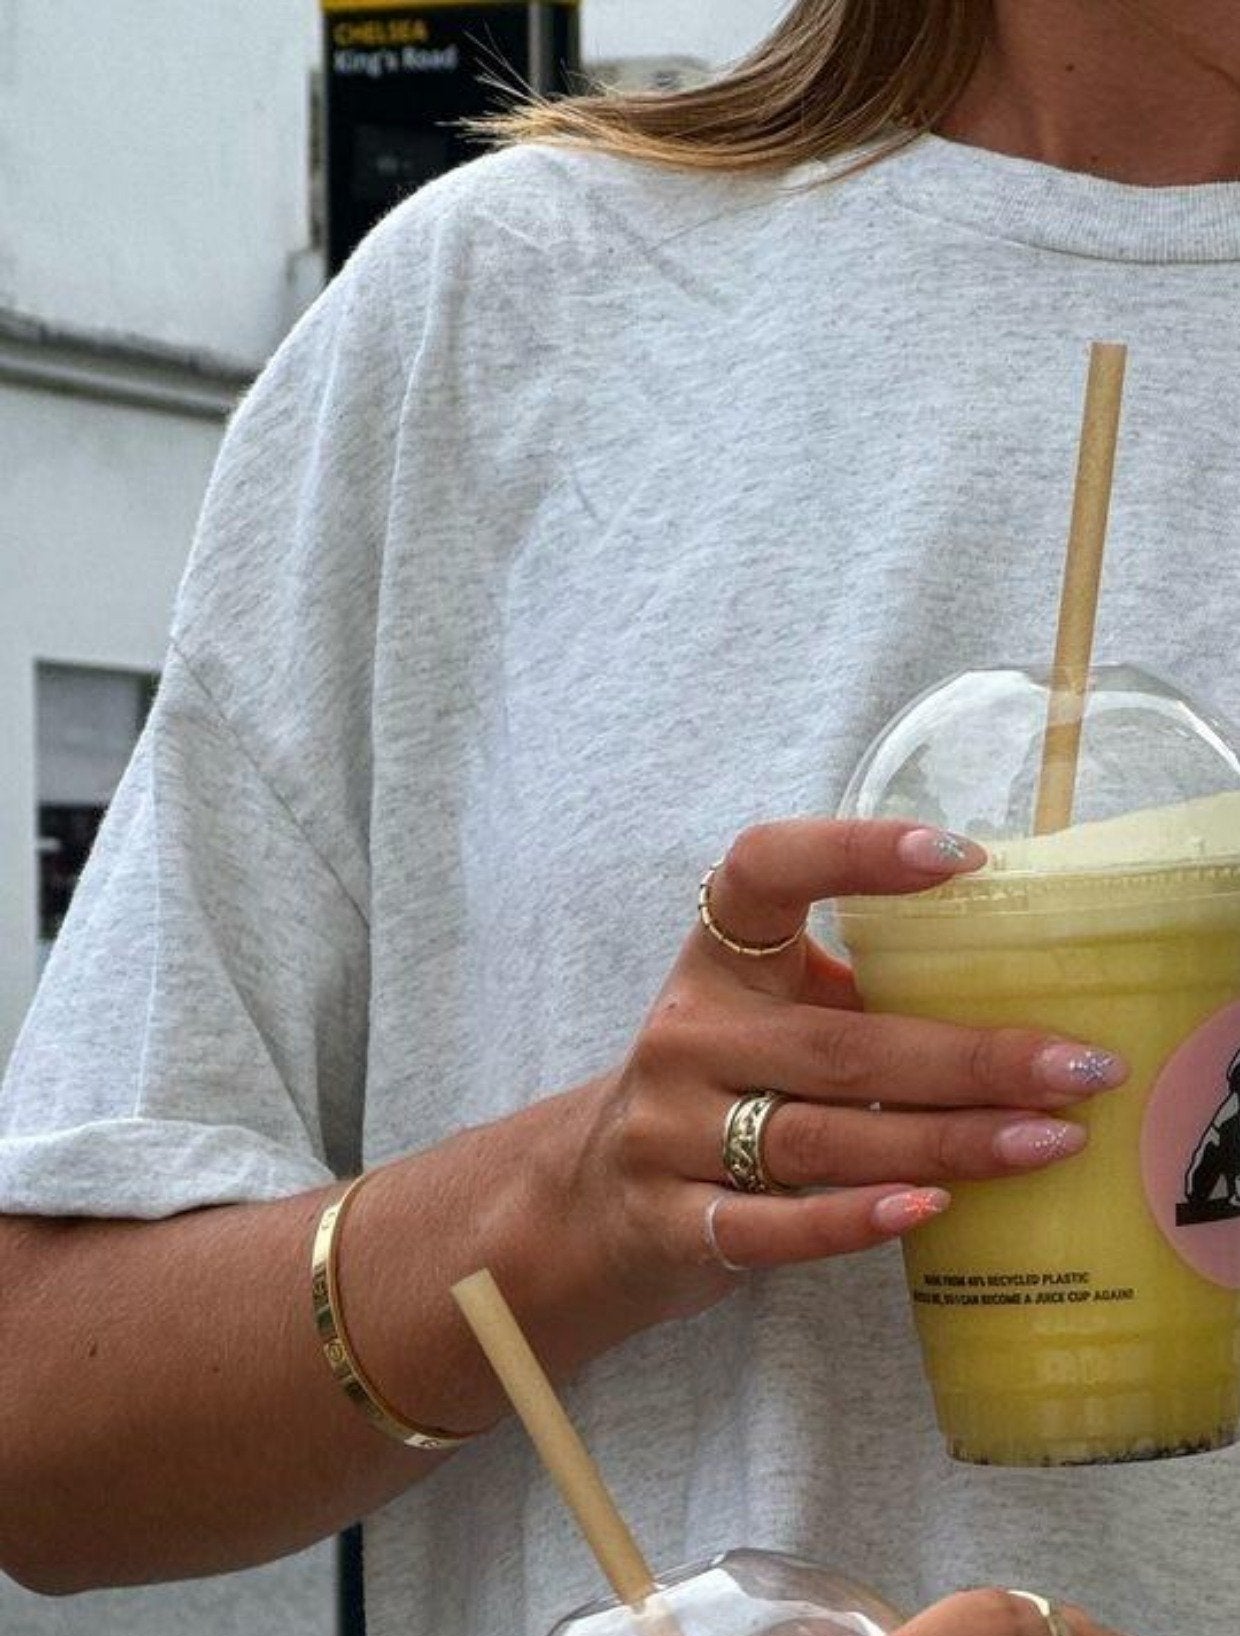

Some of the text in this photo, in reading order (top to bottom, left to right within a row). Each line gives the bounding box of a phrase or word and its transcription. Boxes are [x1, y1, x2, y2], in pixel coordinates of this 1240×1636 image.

[333, 19, 429, 46] CHELSEA
[334, 44, 459, 77] King's Road
[986, 1273, 1040, 1287] RECYCLED
[1042, 1271, 1089, 1286] PLASTIC
[1023, 1291, 1032, 1305] A
[1035, 1290, 1064, 1305] JUICE
[1067, 1288, 1090, 1303] CUP
